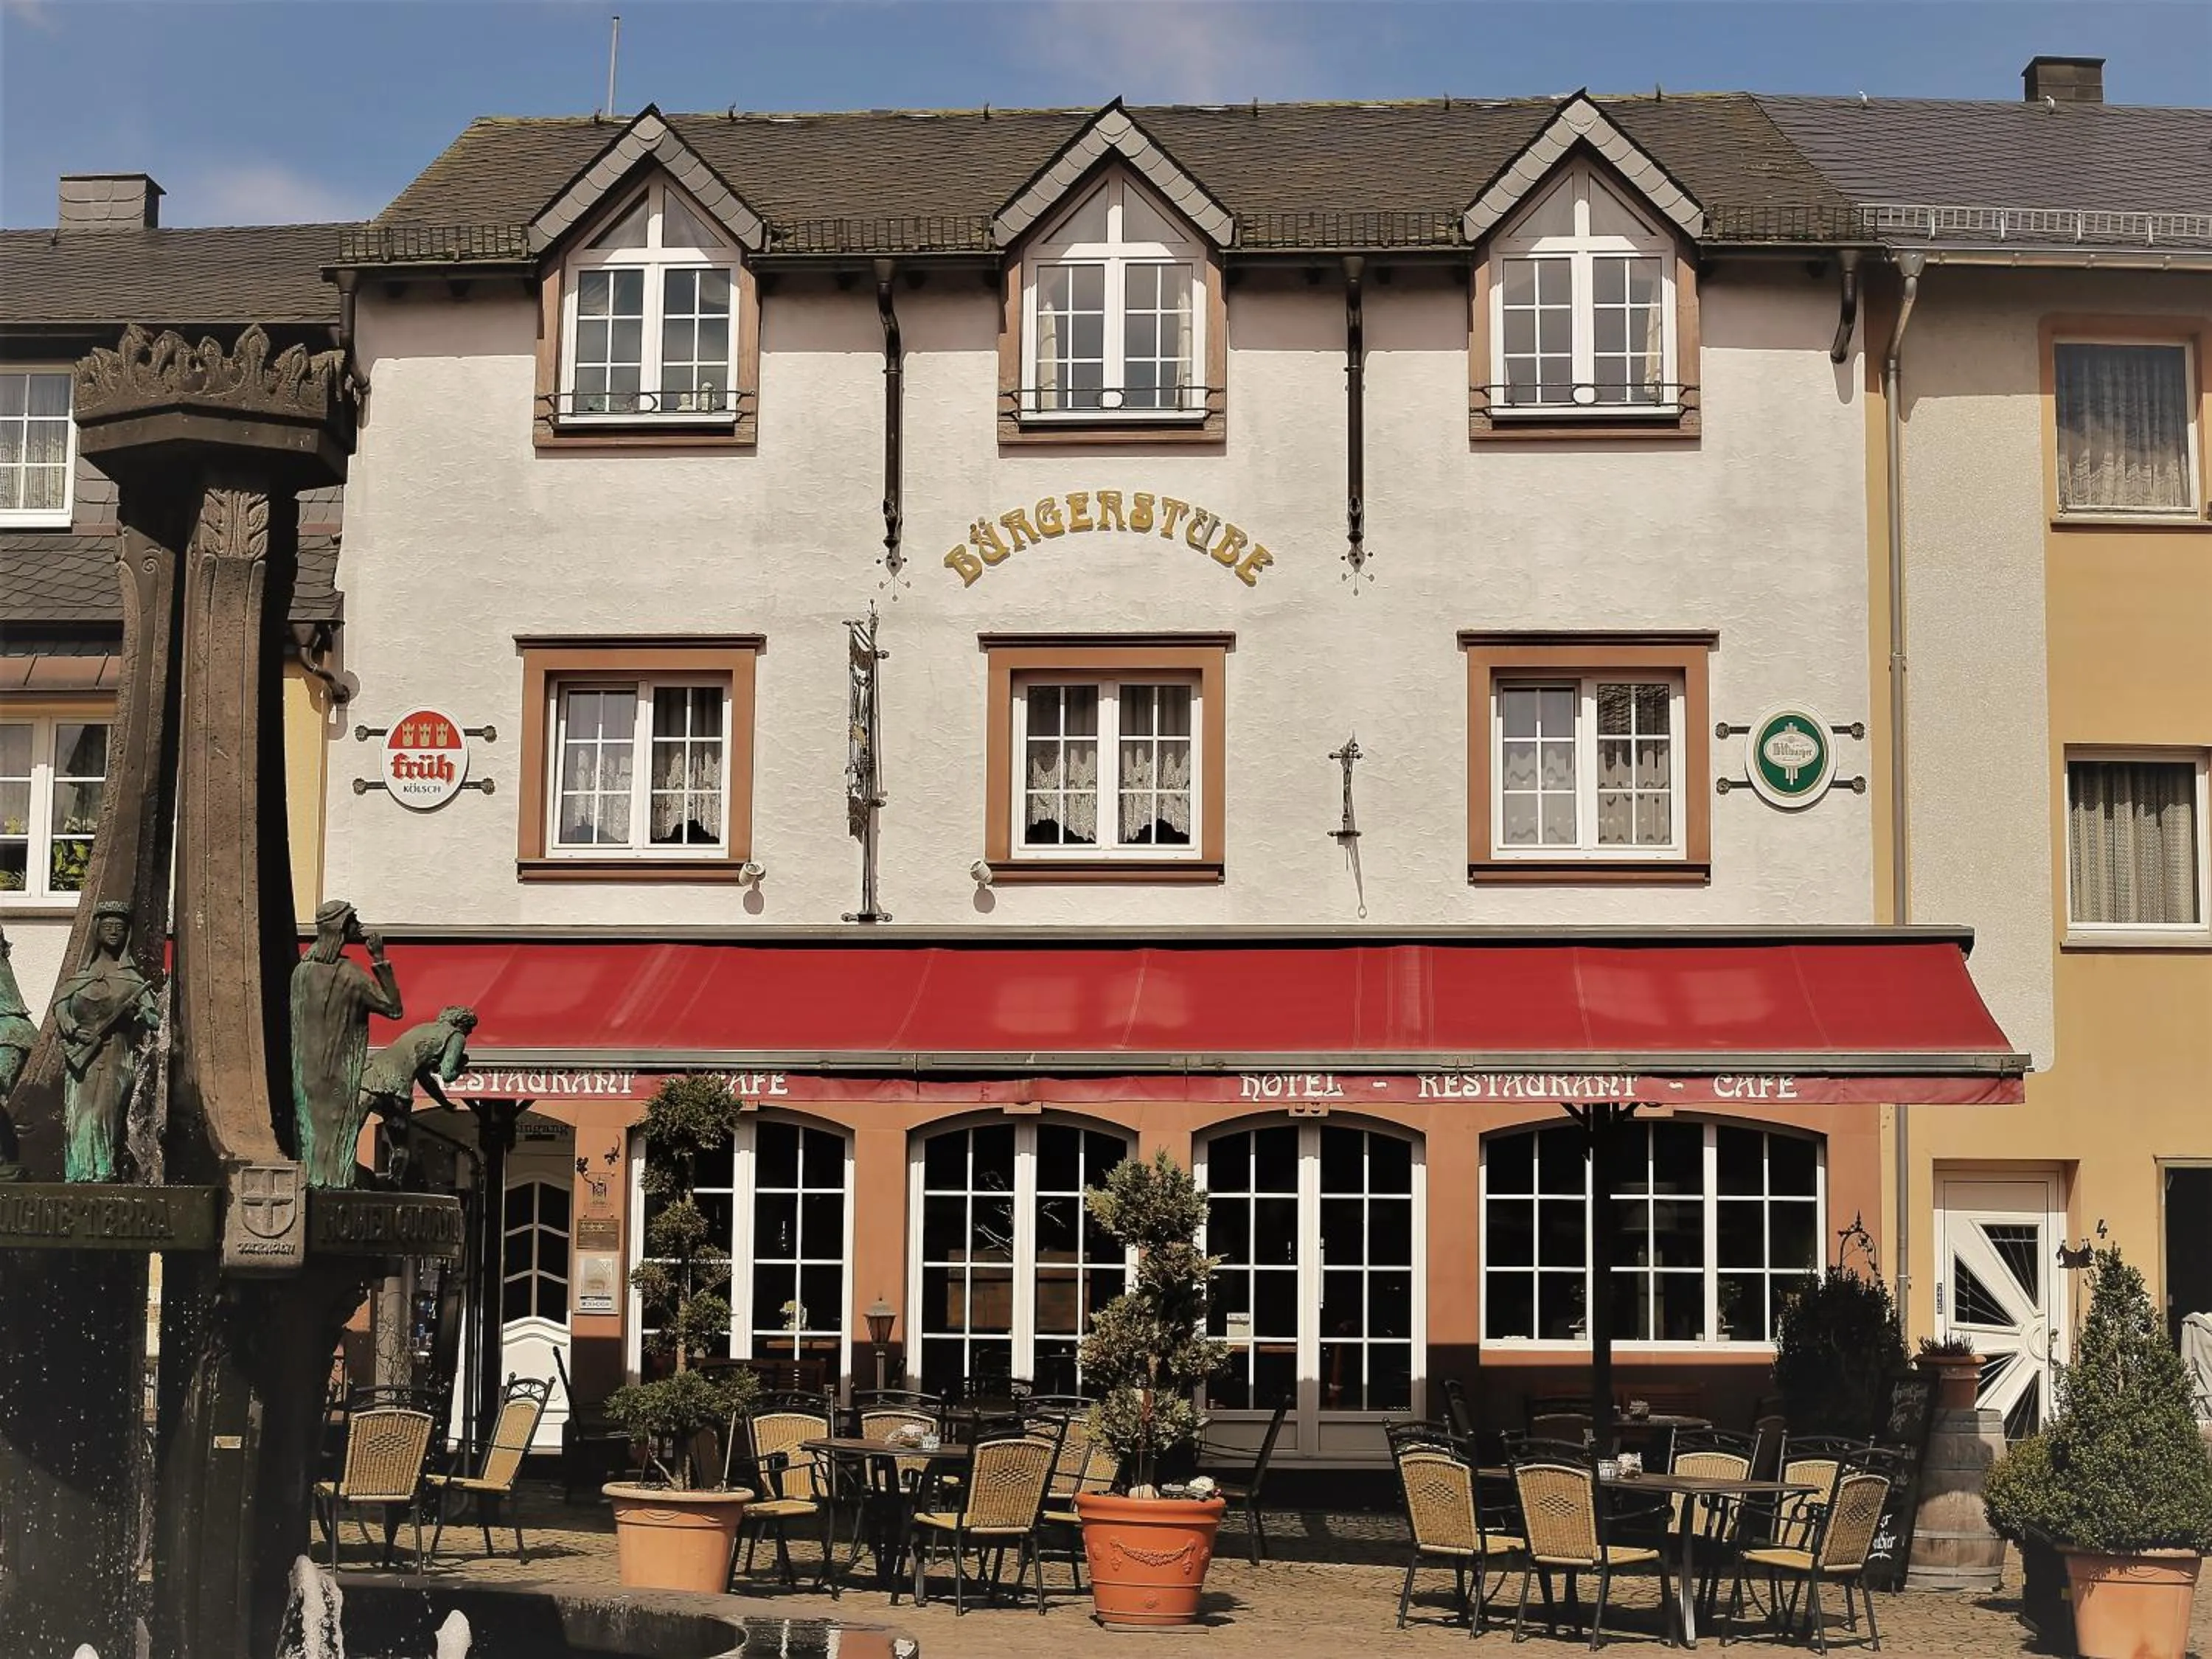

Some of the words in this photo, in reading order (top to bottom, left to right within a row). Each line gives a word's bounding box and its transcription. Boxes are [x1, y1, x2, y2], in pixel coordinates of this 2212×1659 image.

[943, 490, 1275, 588] BÜRGERSTUBE
[391, 752, 456, 785] früh
[403, 783, 442, 794] KÖLSCH
[706, 1069, 788, 1095] AFE
[1239, 1073, 1344, 1102] HOTEL
[1417, 1073, 1641, 1098] RESTAURANT
[1712, 1074, 1798, 1098] CAFE
[2096, 1219, 2108, 1239] 4
